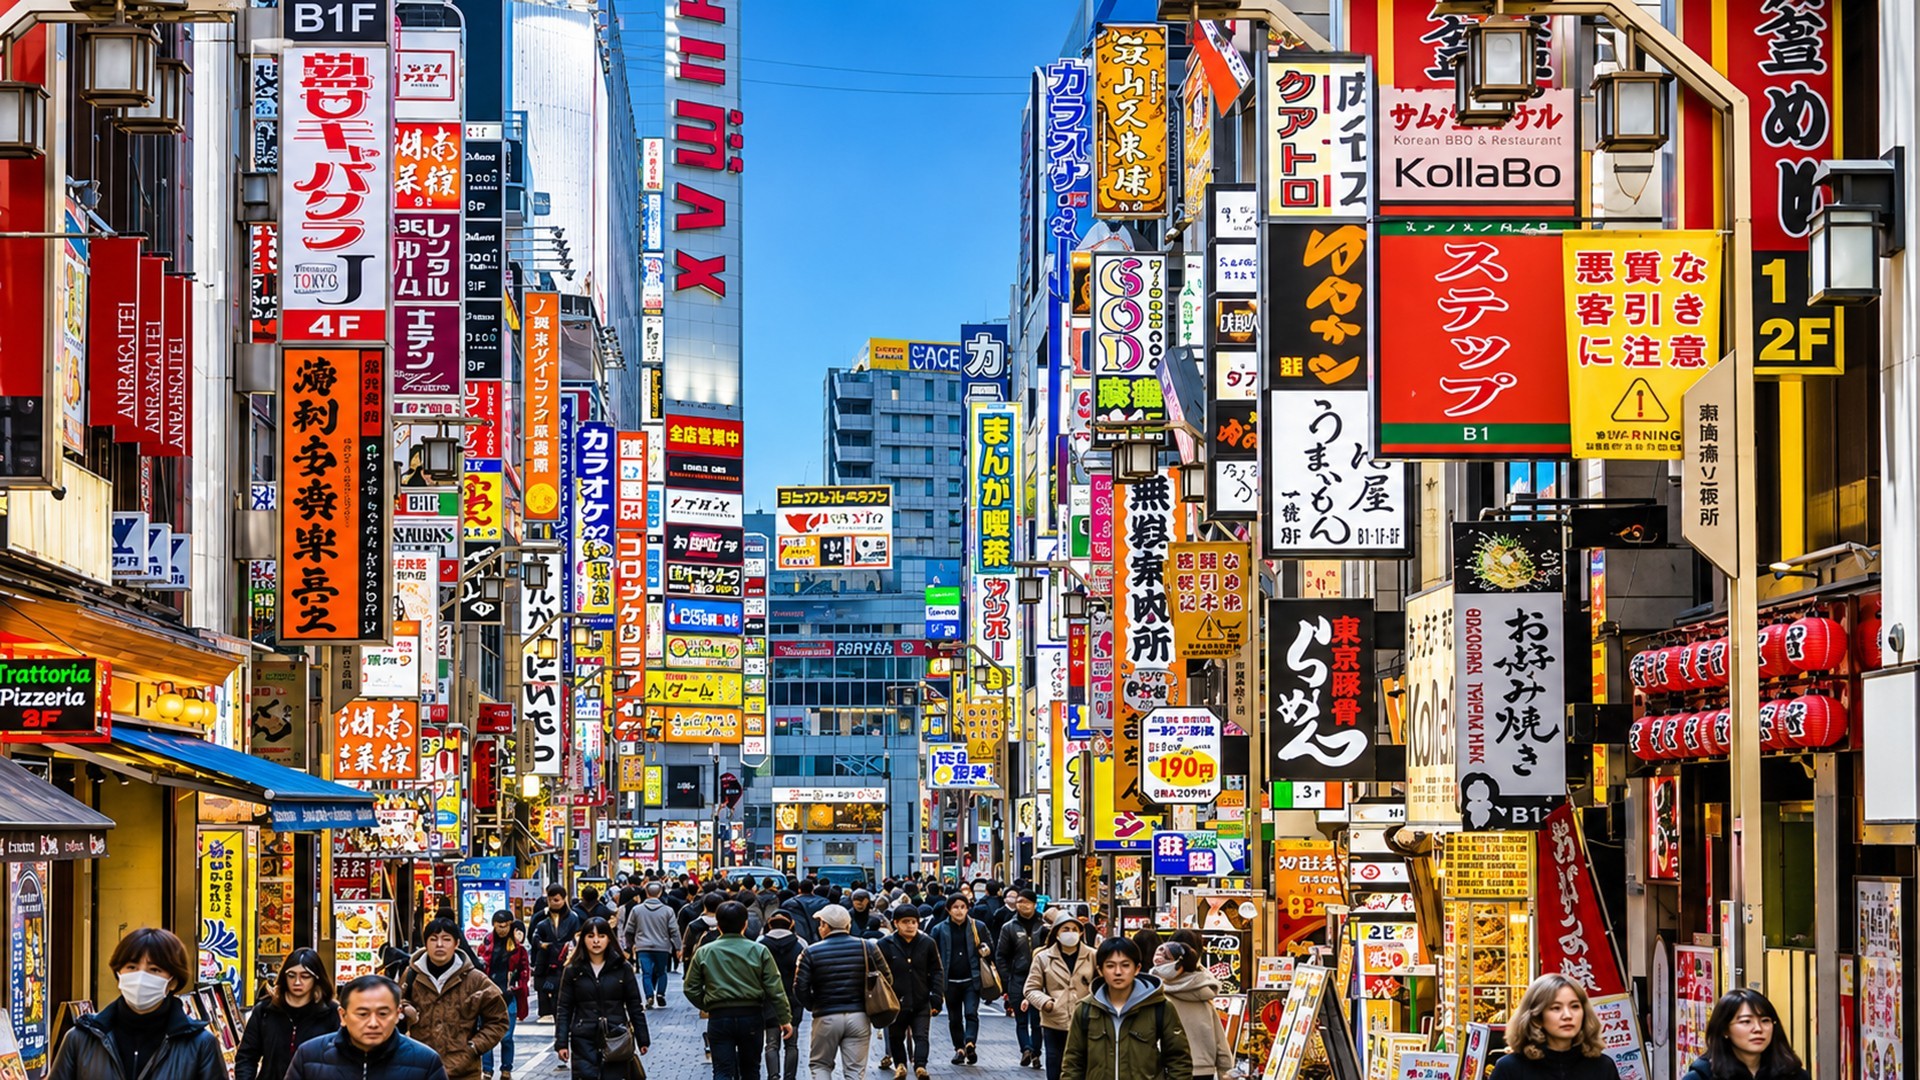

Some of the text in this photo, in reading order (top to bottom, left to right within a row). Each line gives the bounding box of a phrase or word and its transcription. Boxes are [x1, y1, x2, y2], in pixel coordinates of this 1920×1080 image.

[294, 3, 377, 33] B1F
[1277, 69, 1318, 208] クアトロ
[1394, 135, 1440, 146] Korean
[1478, 135, 1487, 146] &
[1492, 135, 1563, 146] Restaurant
[1395, 157, 1562, 188] KollaBo
[426, 218, 450, 297] レンタル
[1576, 250, 1708, 284] 悪質な
[293, 273, 339, 291] TOKYO
[316, 254, 376, 305] J
[1576, 292, 1706, 326] 客引き
[308, 315, 360, 338] 4F
[1434, 241, 1518, 418] ステップ
[1758, 318, 1831, 361] 2F
[1578, 334, 1708, 369] に注意
[1463, 426, 1489, 441] B1
[581, 428, 611, 523] カラオケ
[1304, 399, 1351, 545] うまいもん
[0, 663, 92, 684] Trattoria
[0, 686, 86, 707] Pizzeria
[1159, 756, 1214, 778] 190円
